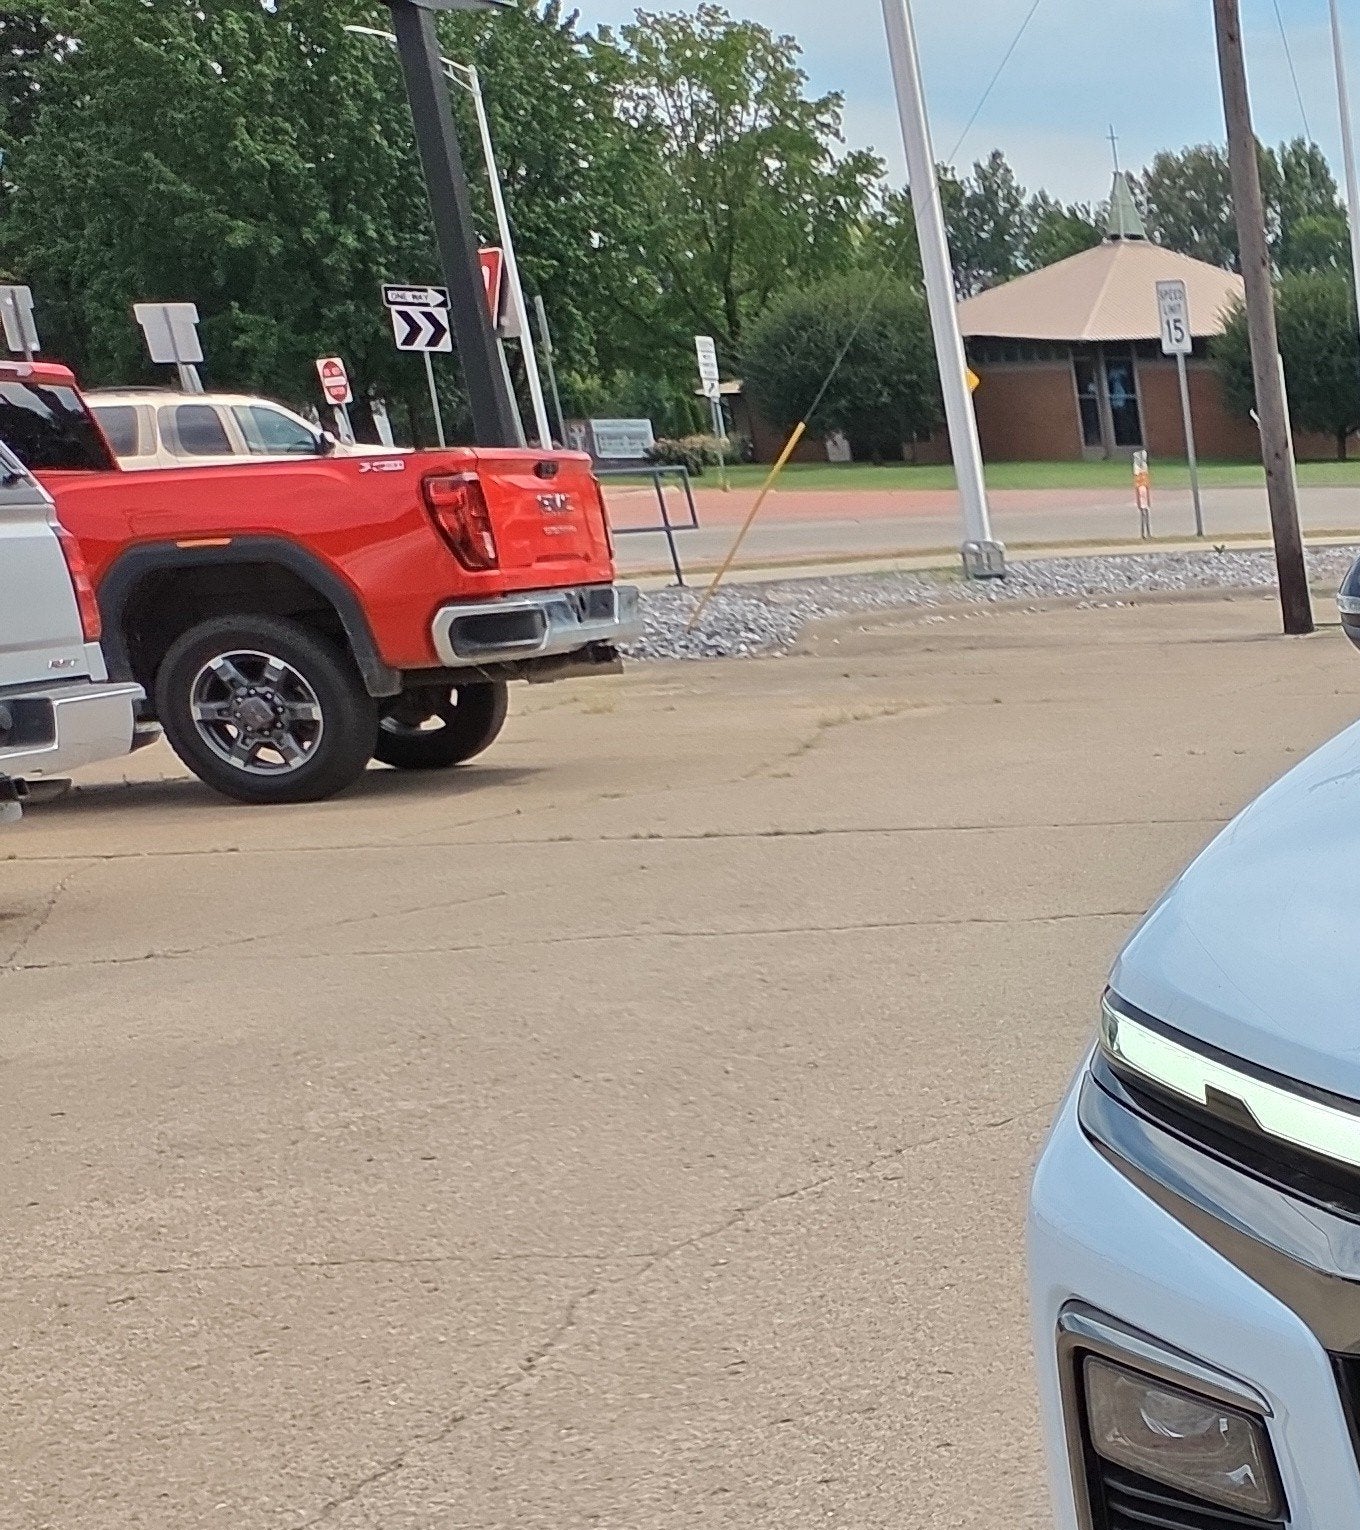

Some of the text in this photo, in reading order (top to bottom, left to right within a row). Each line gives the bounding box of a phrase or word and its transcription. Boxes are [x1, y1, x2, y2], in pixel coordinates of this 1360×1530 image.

[390, 292, 429, 301] ONE WAY
[1159, 289, 1183, 301] SPEED
[1166, 318, 1185, 344] 15
